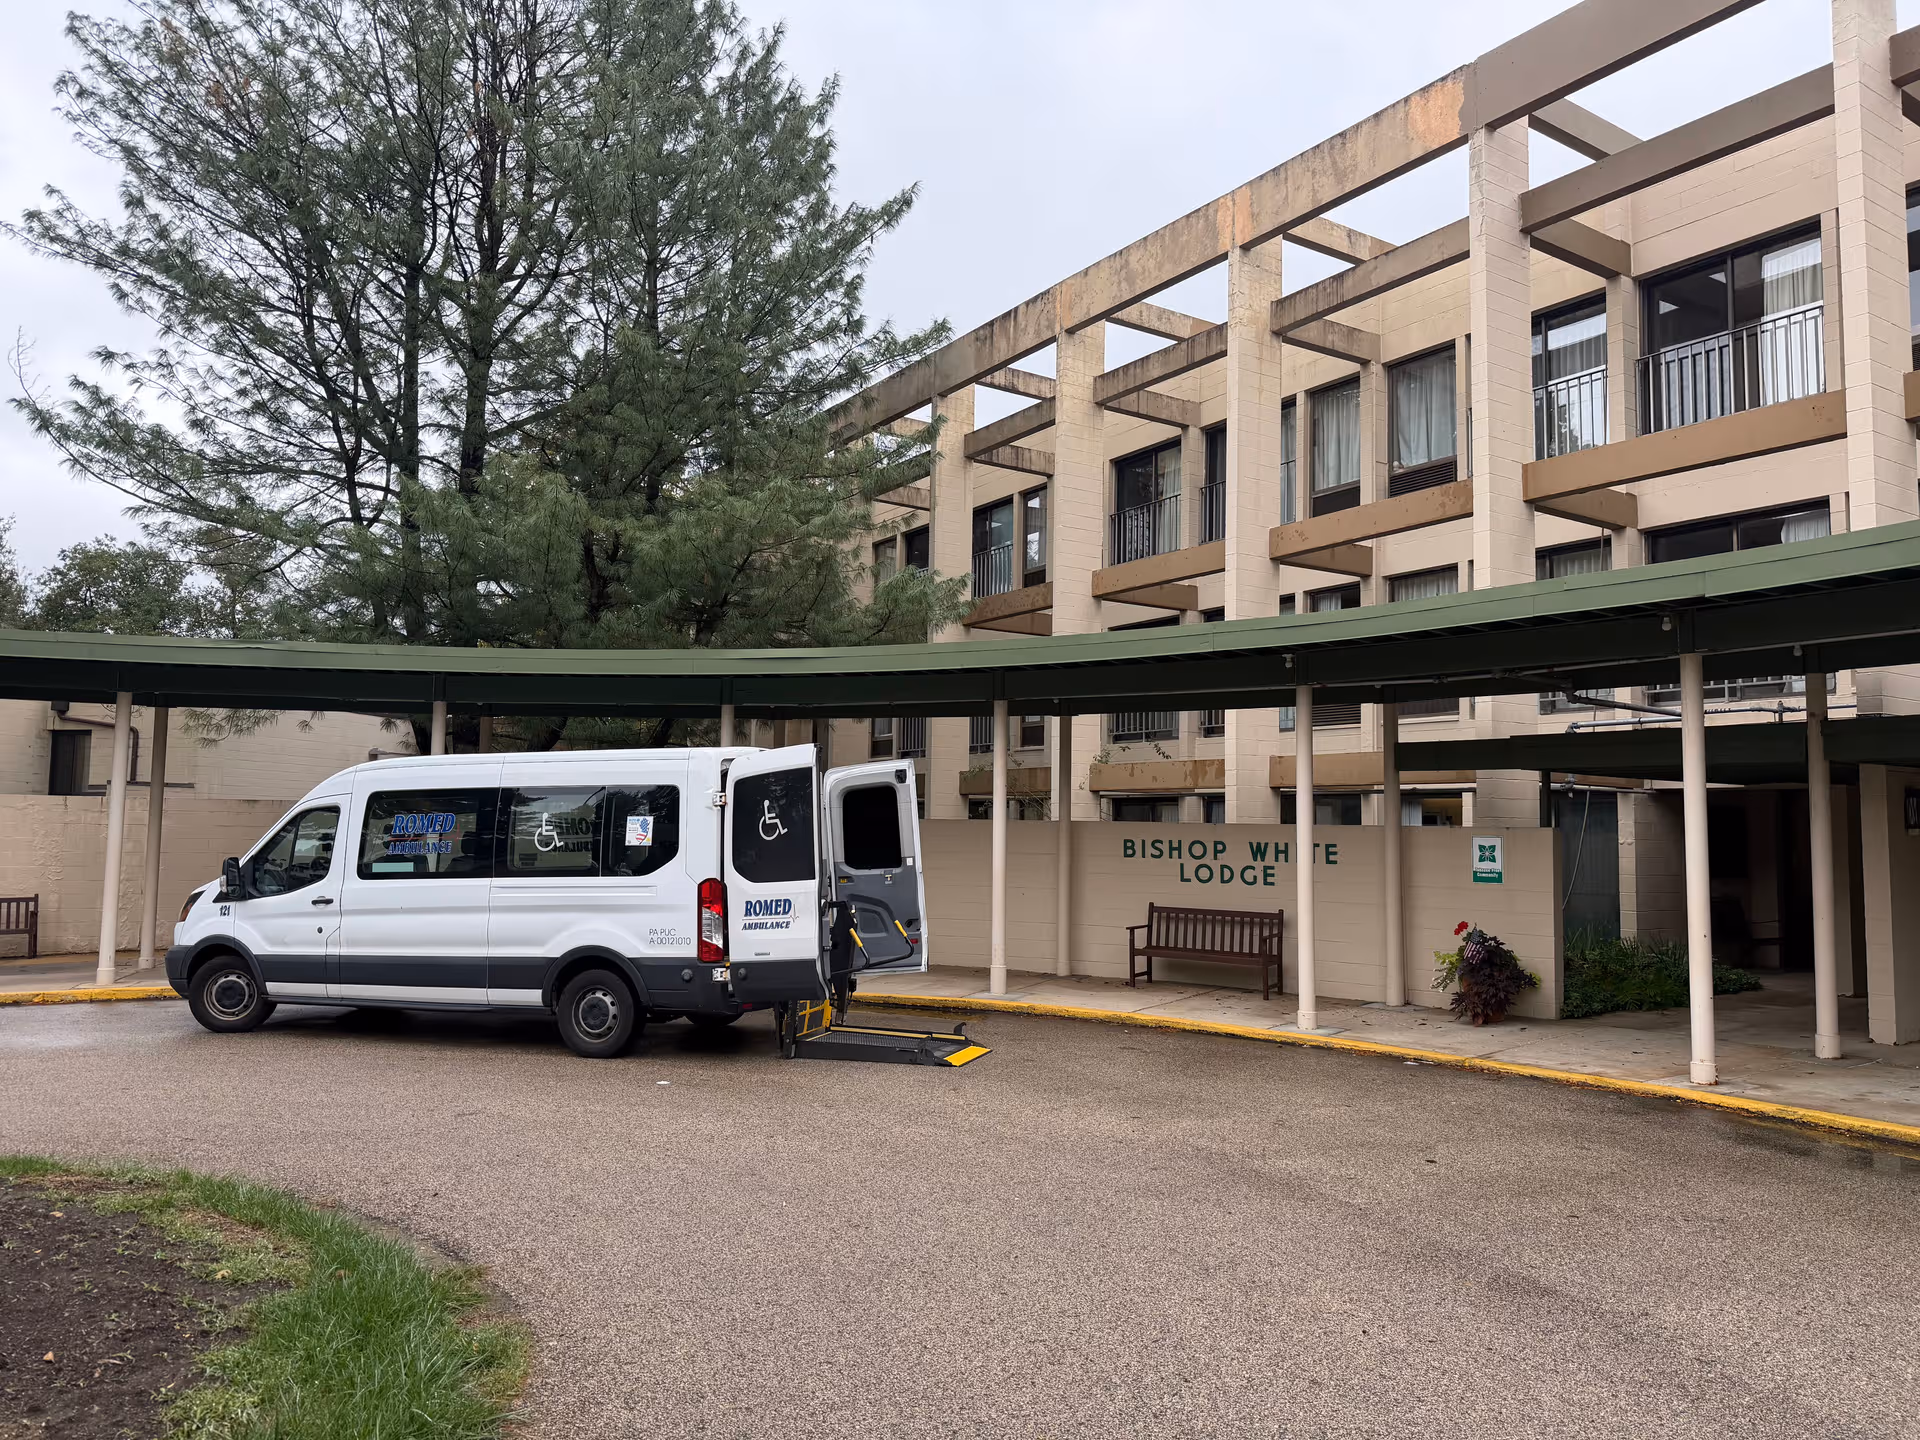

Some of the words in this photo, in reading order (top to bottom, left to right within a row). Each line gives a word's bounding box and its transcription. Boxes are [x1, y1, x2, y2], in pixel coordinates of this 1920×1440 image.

[391, 813, 456, 835] ROMED
[387, 841, 452, 855] AMBULANCE
[1123, 838, 1227, 861] BISHOP
[1248, 841, 1339, 865] WHTE
[1179, 862, 1276, 886] LODGE
[219, 904, 231, 917] 121
[744, 898, 792, 917] ROMED
[648, 928, 658, 936] PA
[660, 928, 677, 936] PUC
[741, 920, 791, 931] AMBULANCE
